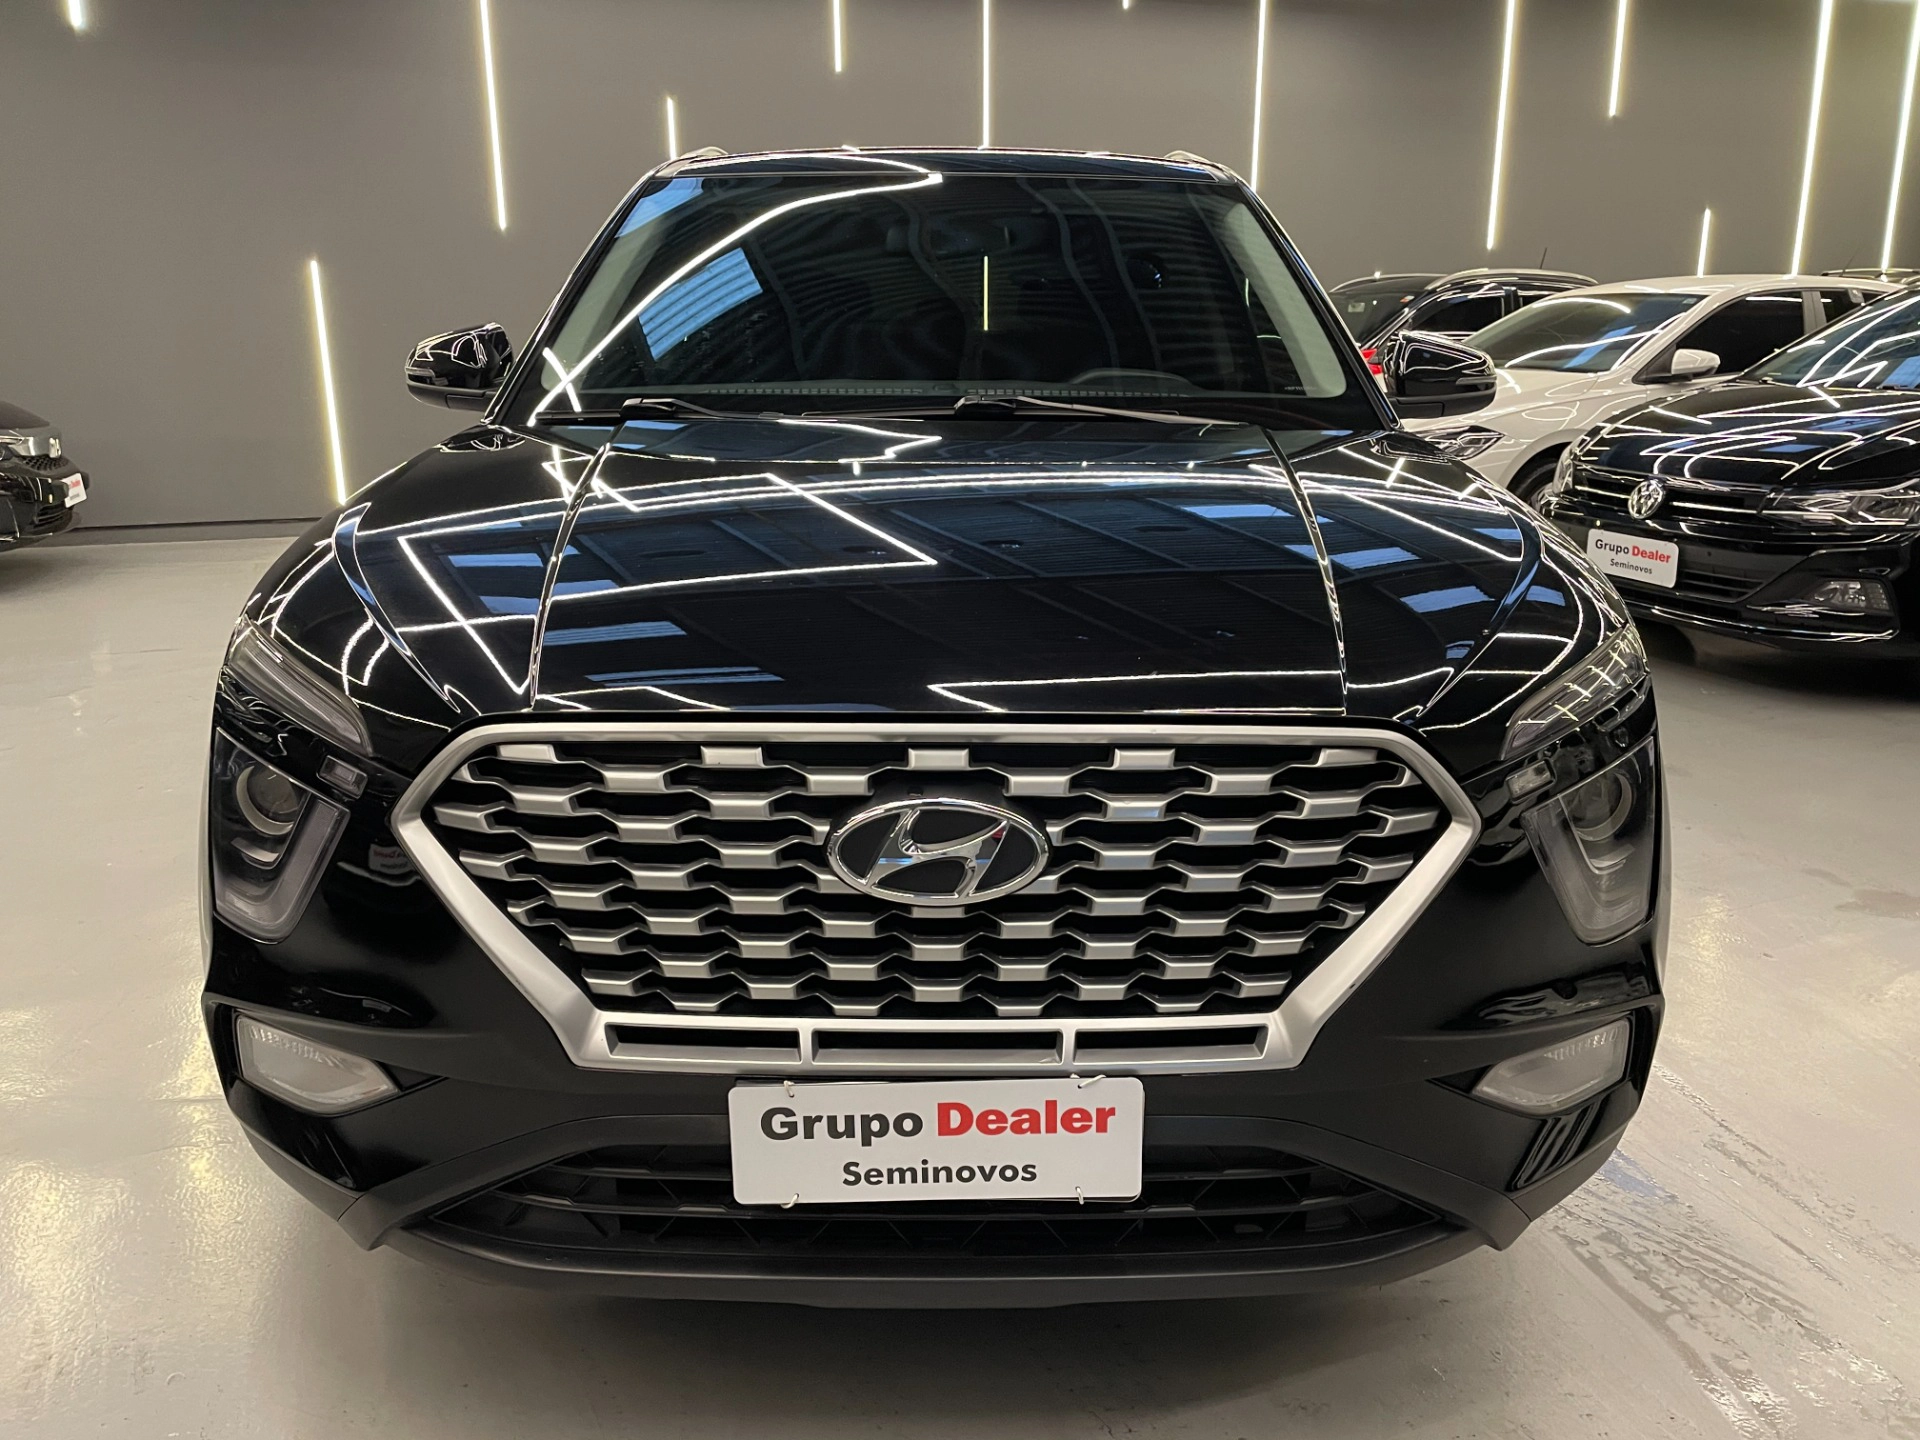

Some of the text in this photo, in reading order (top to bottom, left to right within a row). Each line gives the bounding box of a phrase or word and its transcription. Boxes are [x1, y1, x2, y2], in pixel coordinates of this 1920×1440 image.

[1595, 539, 1671, 563] Grupo Dealer
[1610, 558, 1652, 574] Seminovos
[760, 1100, 1116, 1147] Grupo Dealer
[842, 1159, 1037, 1186] Seminovos
